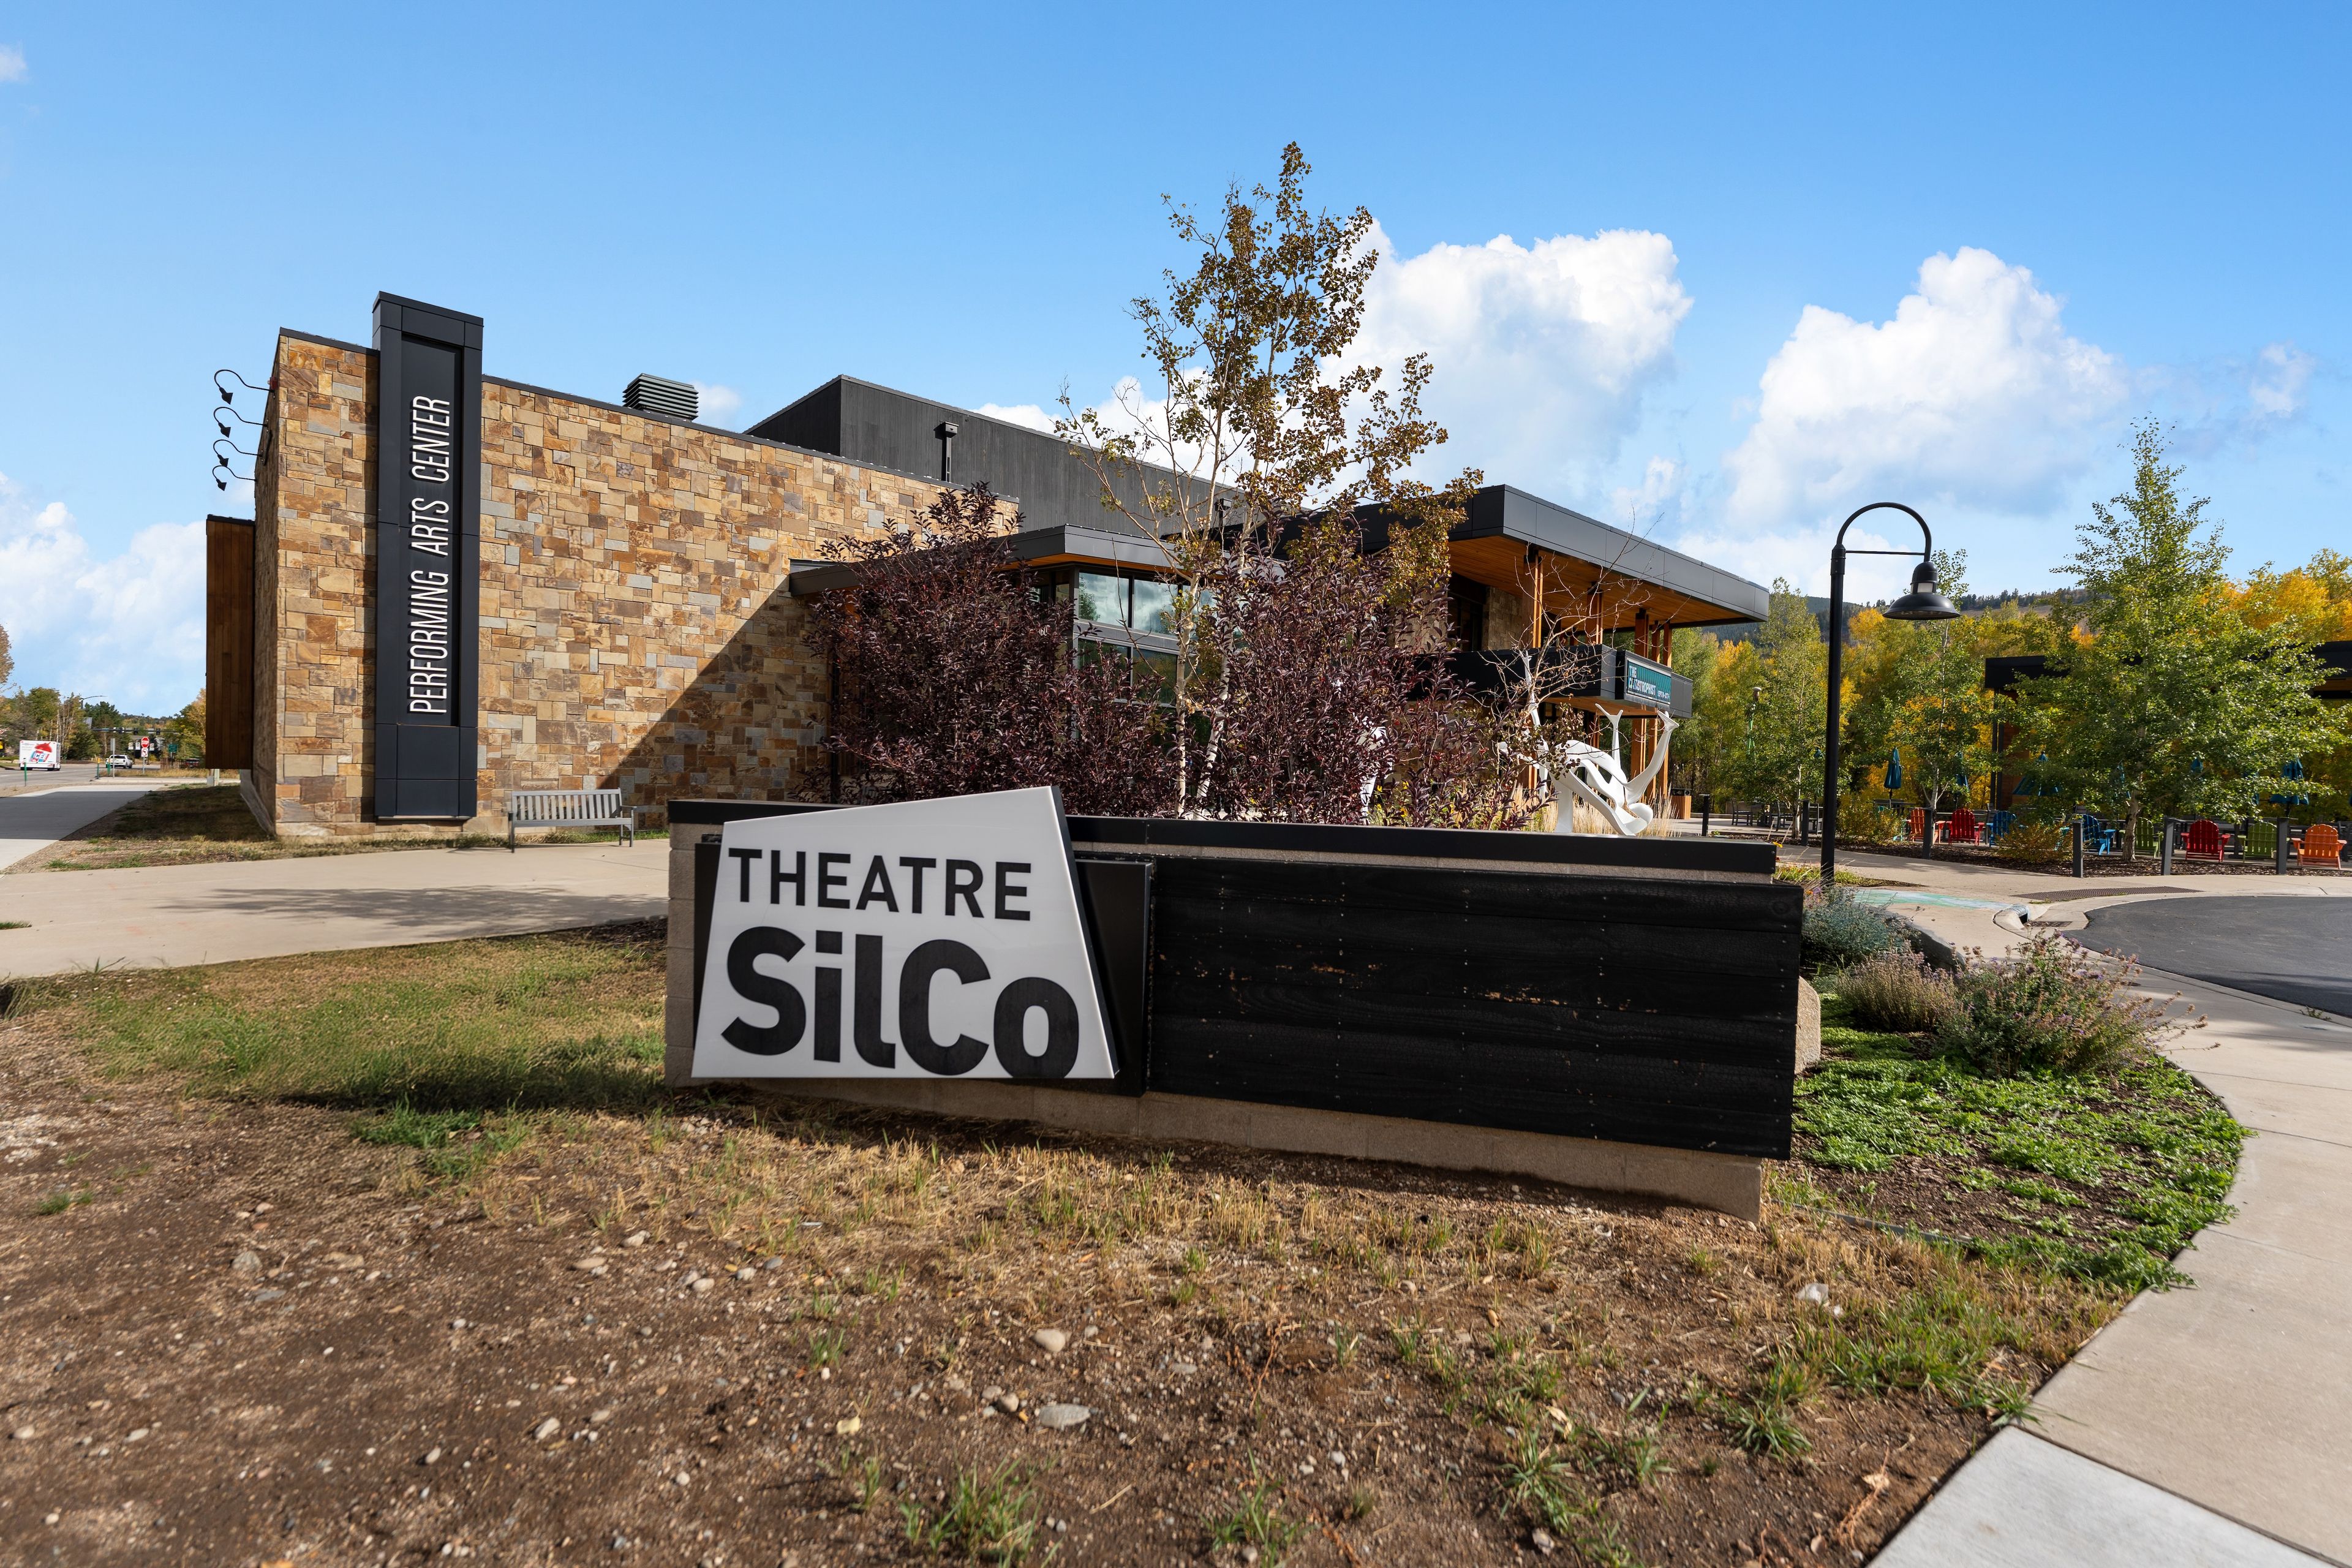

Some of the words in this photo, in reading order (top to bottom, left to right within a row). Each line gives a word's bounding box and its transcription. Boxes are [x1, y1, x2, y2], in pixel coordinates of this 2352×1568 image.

[412, 396, 450, 482] CENTER
[411, 497, 449, 556] ARTS
[410, 570, 448, 713] PERFORMING
[728, 848, 1031, 921] THEATRE
[721, 925, 1079, 1079] SilCo
